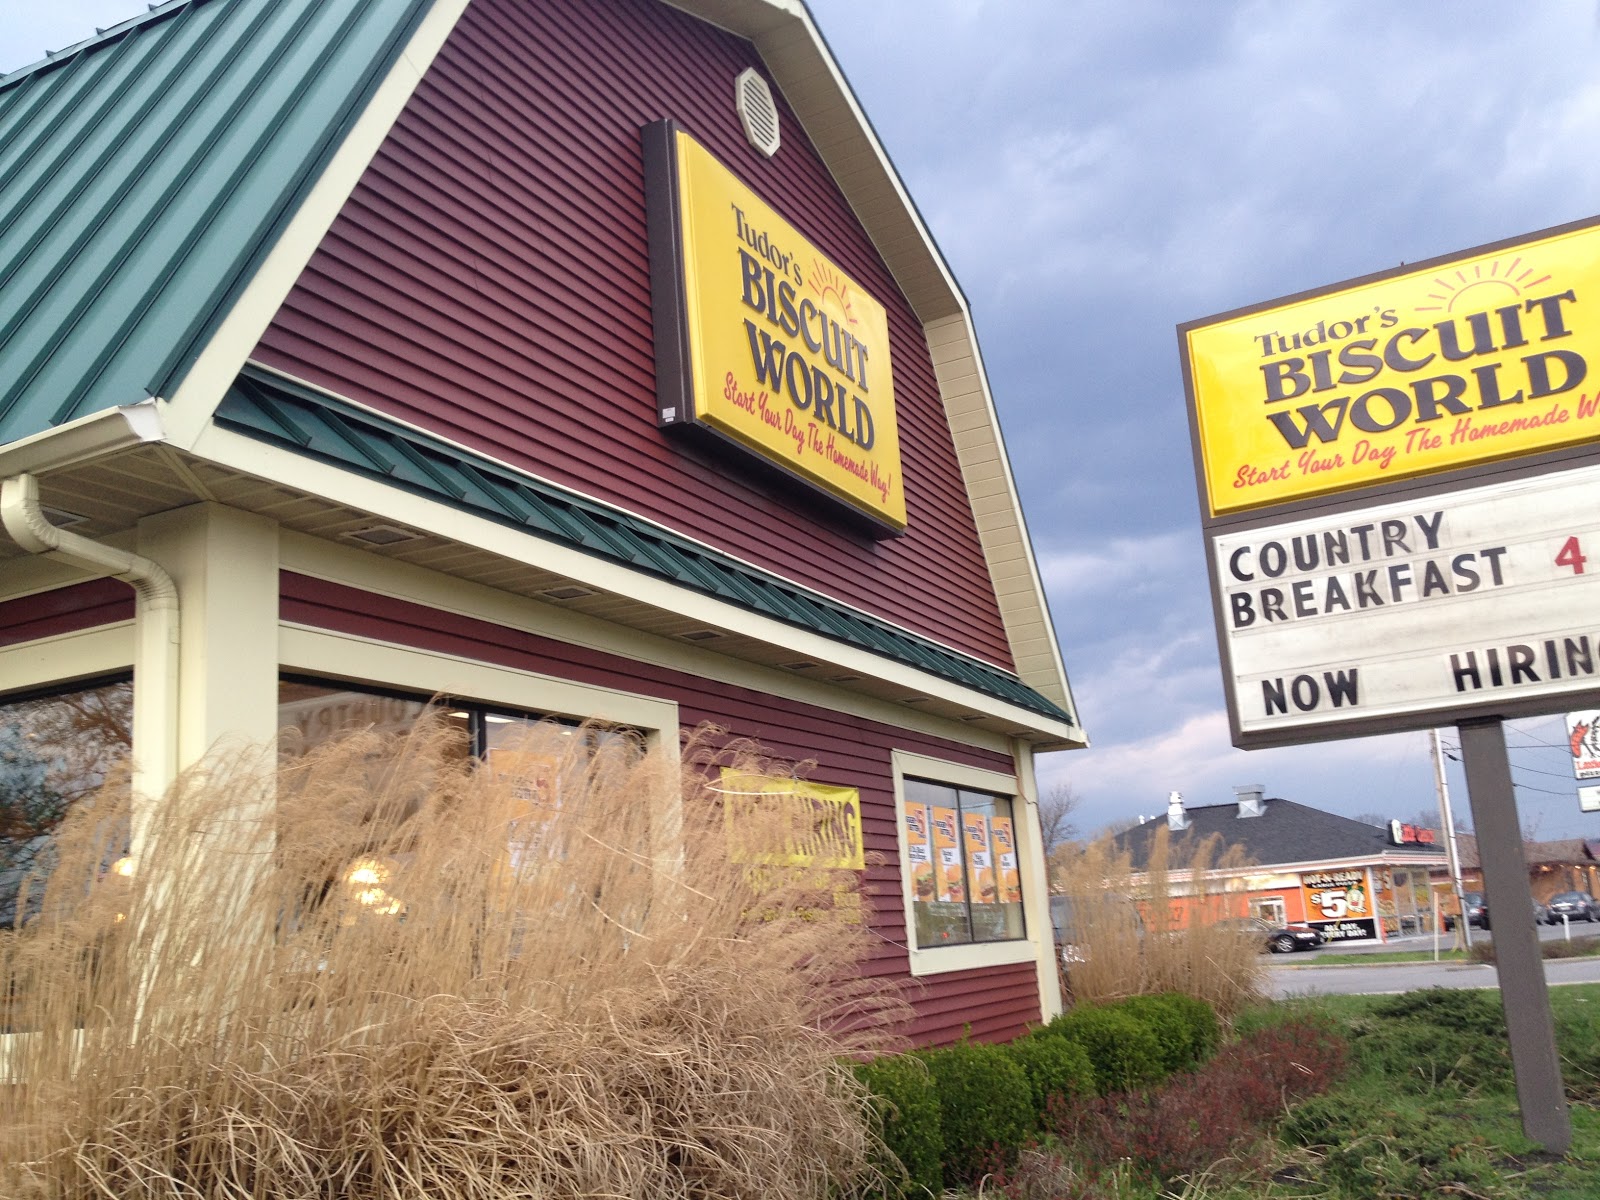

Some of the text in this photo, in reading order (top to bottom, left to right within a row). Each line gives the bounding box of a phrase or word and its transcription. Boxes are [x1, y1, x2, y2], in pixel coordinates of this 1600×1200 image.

[731, 202, 803, 287] Tudor's
[737, 247, 869, 394] BISCUIT
[1254, 307, 1399, 357] Tudor's
[1259, 289, 1577, 405] BISCUIT
[743, 317, 875, 451] WORLD
[1266, 349, 1588, 450] WORLD
[723, 371, 892, 503] Start Your Day The Homemade Way!
[1233, 391, 1600, 490] Start Your Day The Homemade W
[1229, 510, 1444, 582] COUNTRY
[1230, 535, 1587, 628] BREAKFAST 4
[1261, 635, 1600, 716] NOW HIRIN
